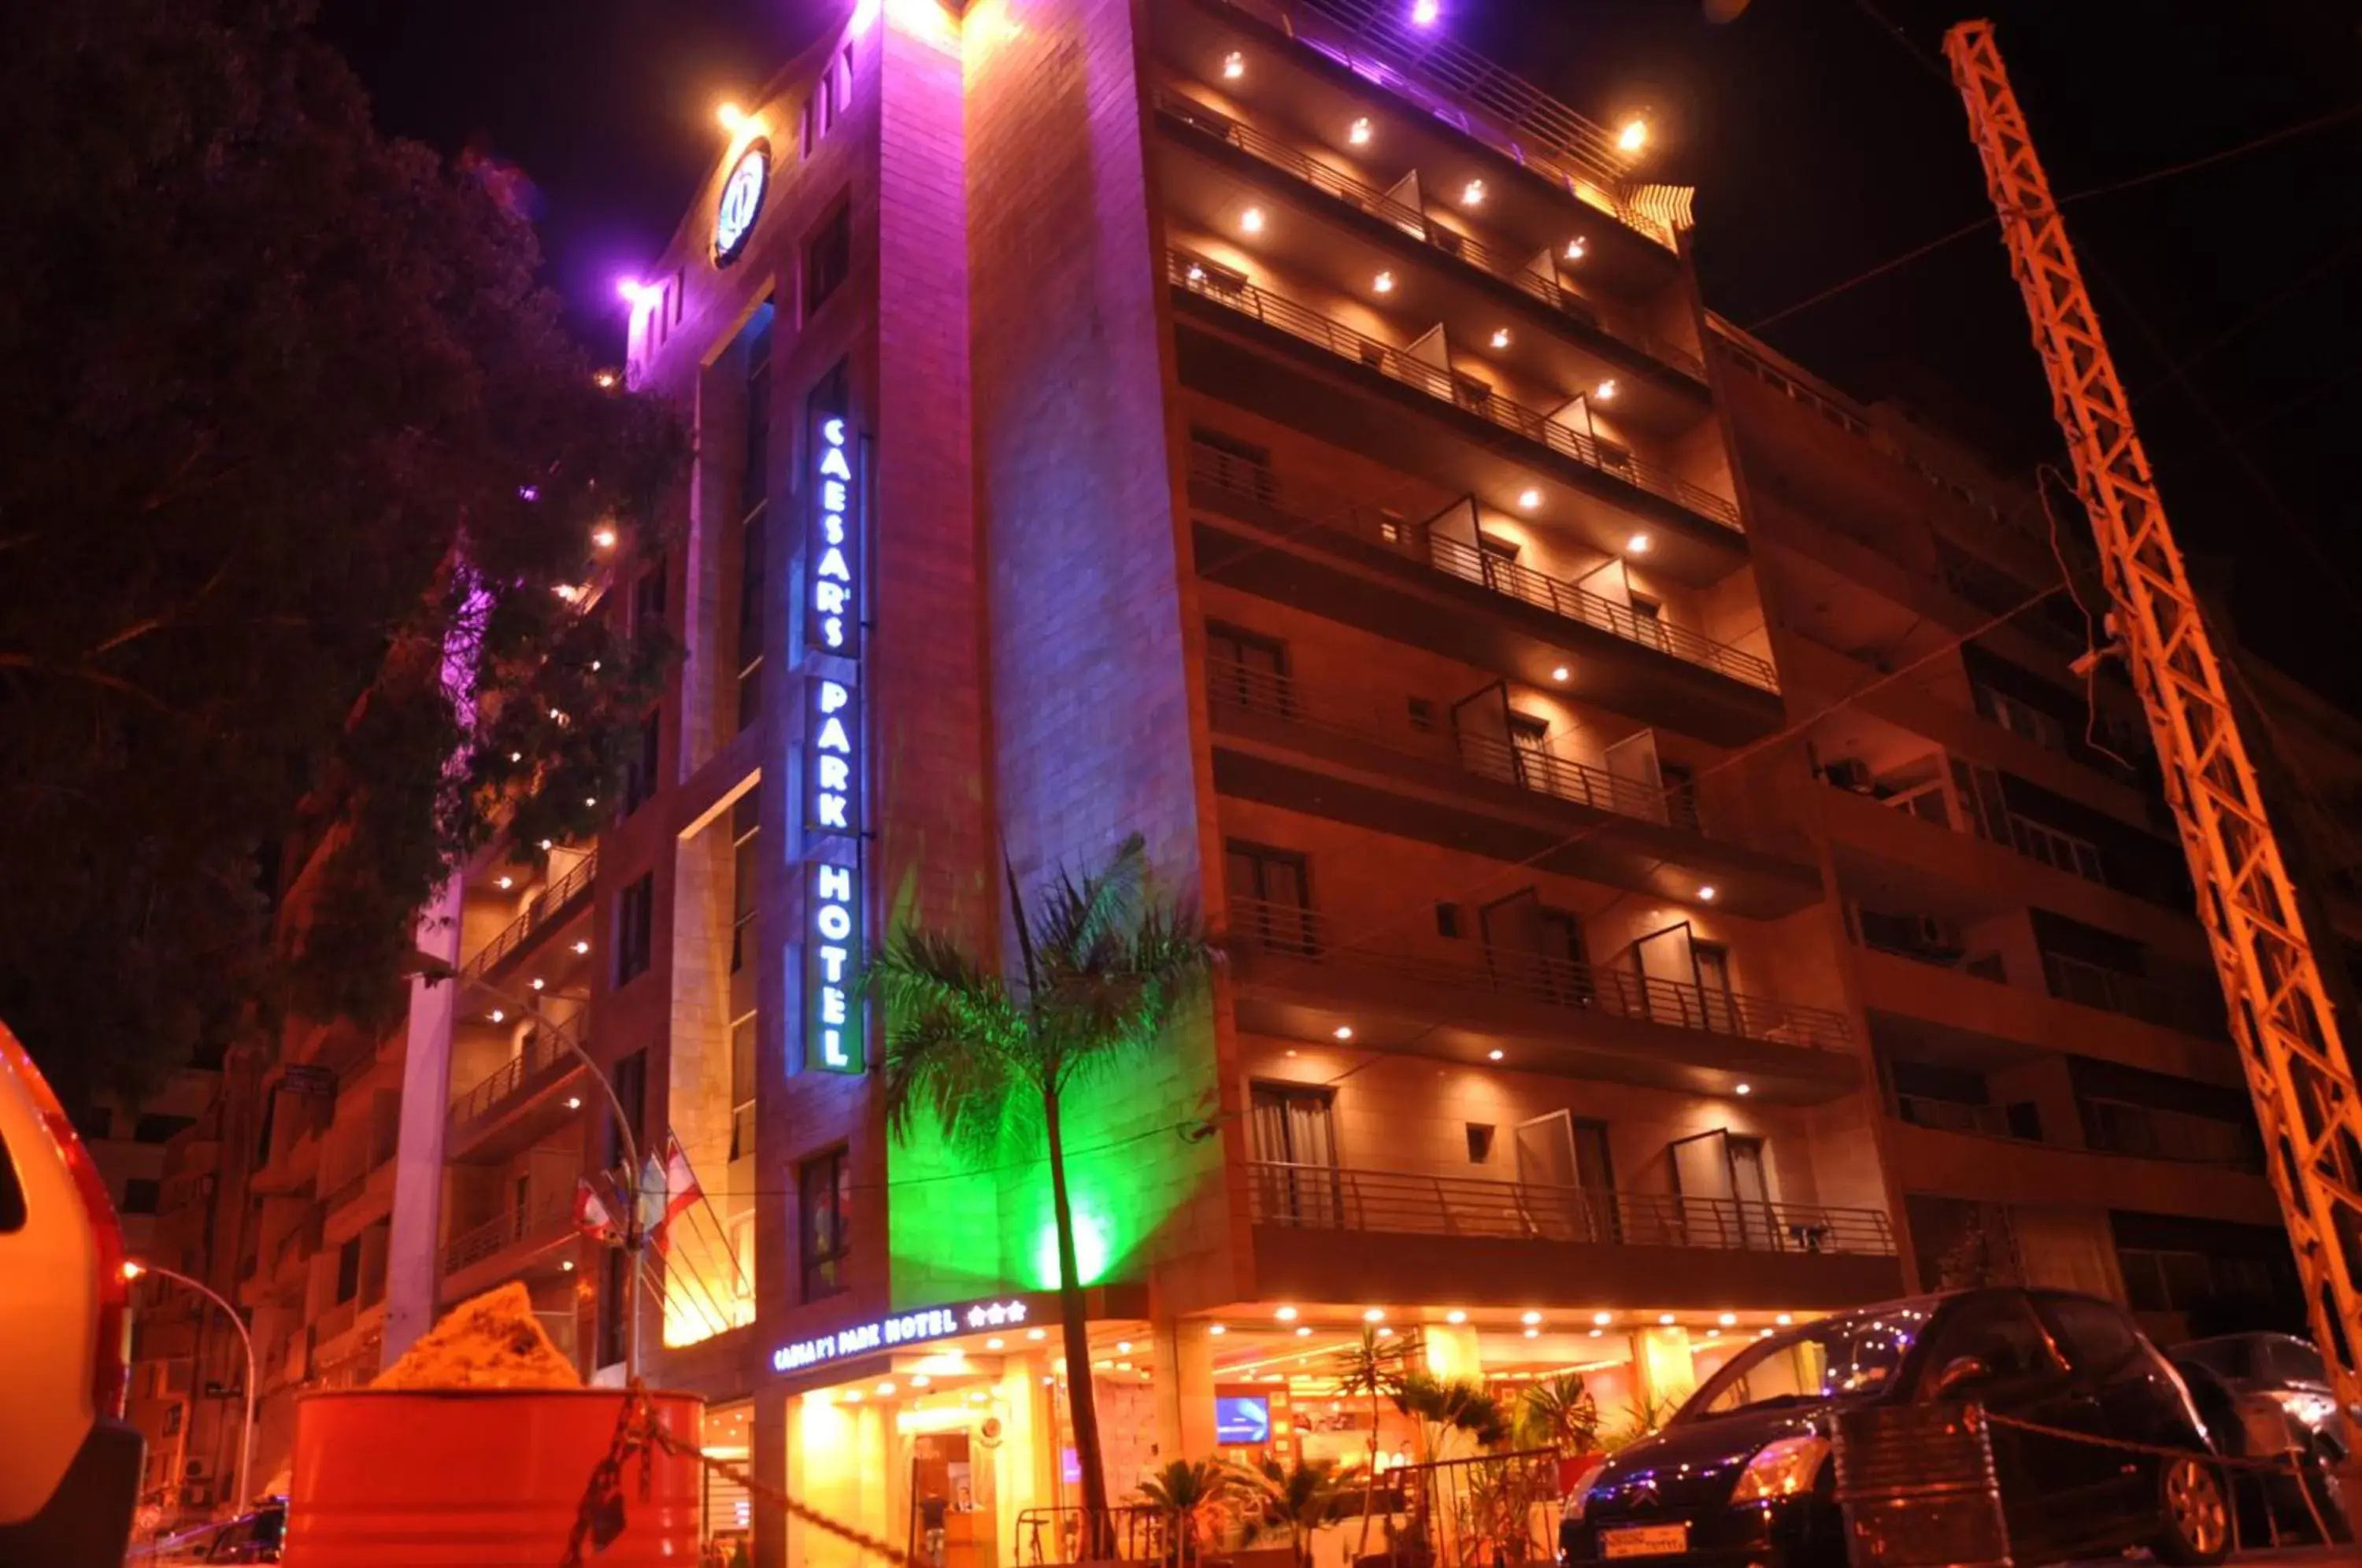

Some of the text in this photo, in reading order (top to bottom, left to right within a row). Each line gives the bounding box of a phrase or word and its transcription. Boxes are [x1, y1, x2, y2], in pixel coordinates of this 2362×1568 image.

[817, 681, 850, 828] PARK
[817, 864, 850, 1068] HOTEL
[839, 1323, 881, 1355] PARK
[885, 1309, 957, 1344] HOTEL
